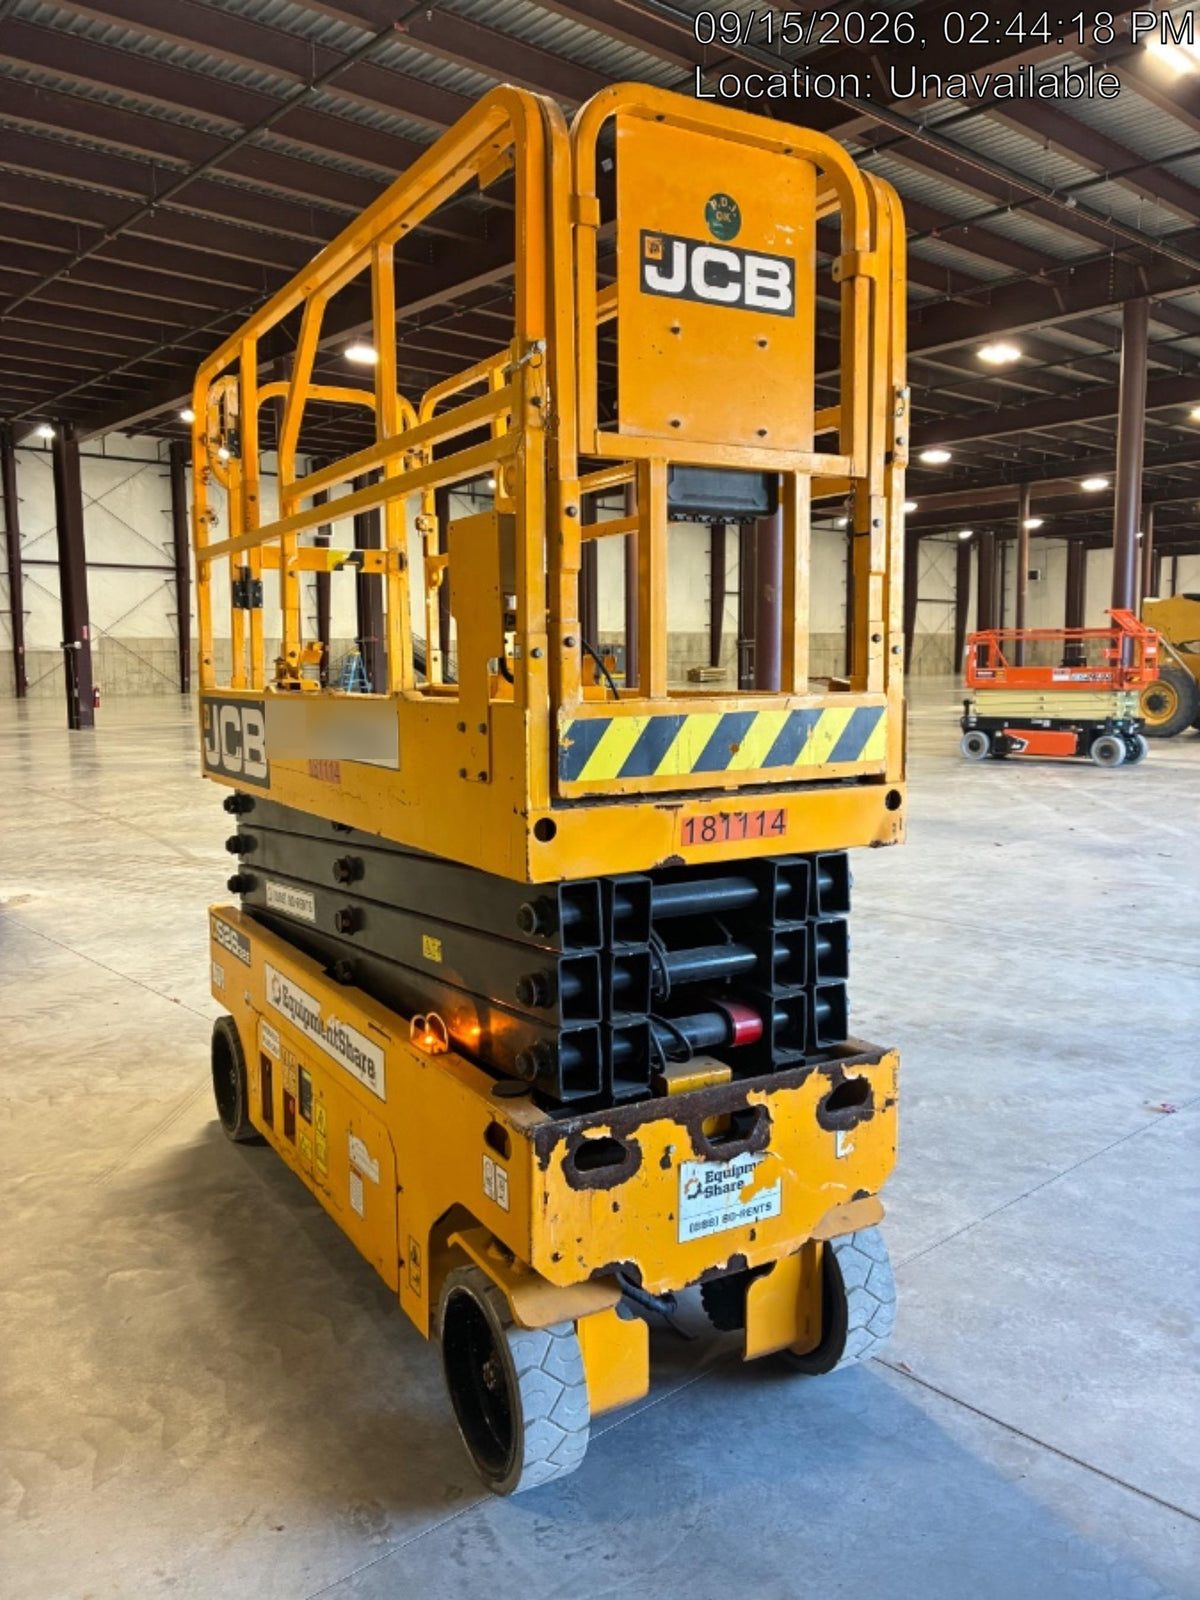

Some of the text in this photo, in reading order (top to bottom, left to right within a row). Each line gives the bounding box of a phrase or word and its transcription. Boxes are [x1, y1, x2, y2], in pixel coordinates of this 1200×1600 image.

[645, 241, 792, 310] JCB
[204, 704, 267, 779] JCB
[686, 808, 786, 844] 181114
[704, 1180, 744, 1199] Share
[705, 1161, 764, 1184] Equipm
